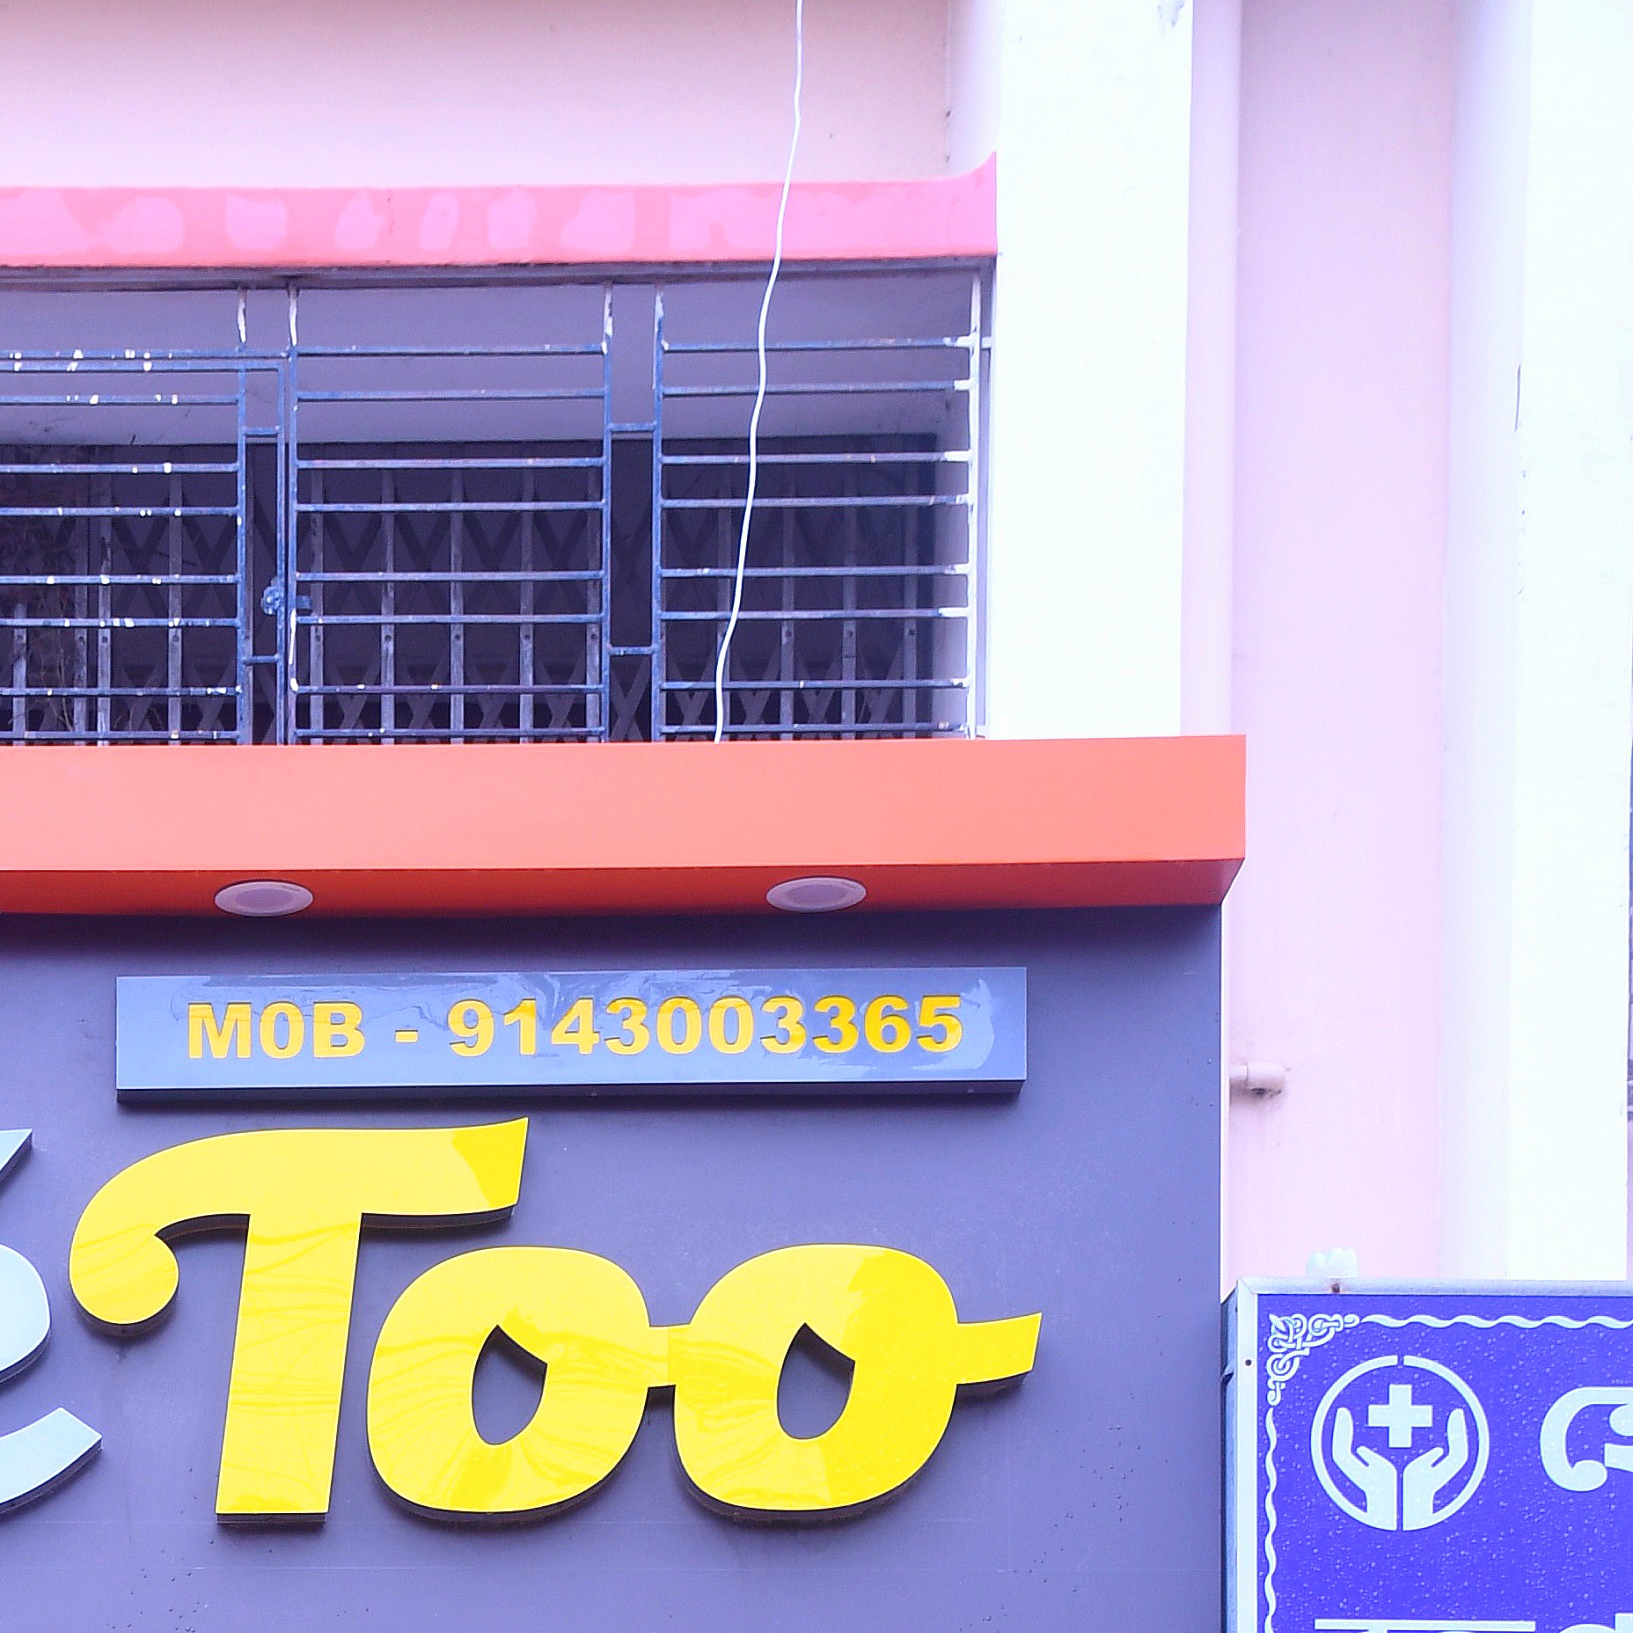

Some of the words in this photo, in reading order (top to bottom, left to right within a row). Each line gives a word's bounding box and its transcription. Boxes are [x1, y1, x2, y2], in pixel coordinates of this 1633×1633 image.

[188, 1001, 366, 1059] MOB
[447, 994, 963, 1057] 9143003365
[68, 1114, 1044, 1524] Too
